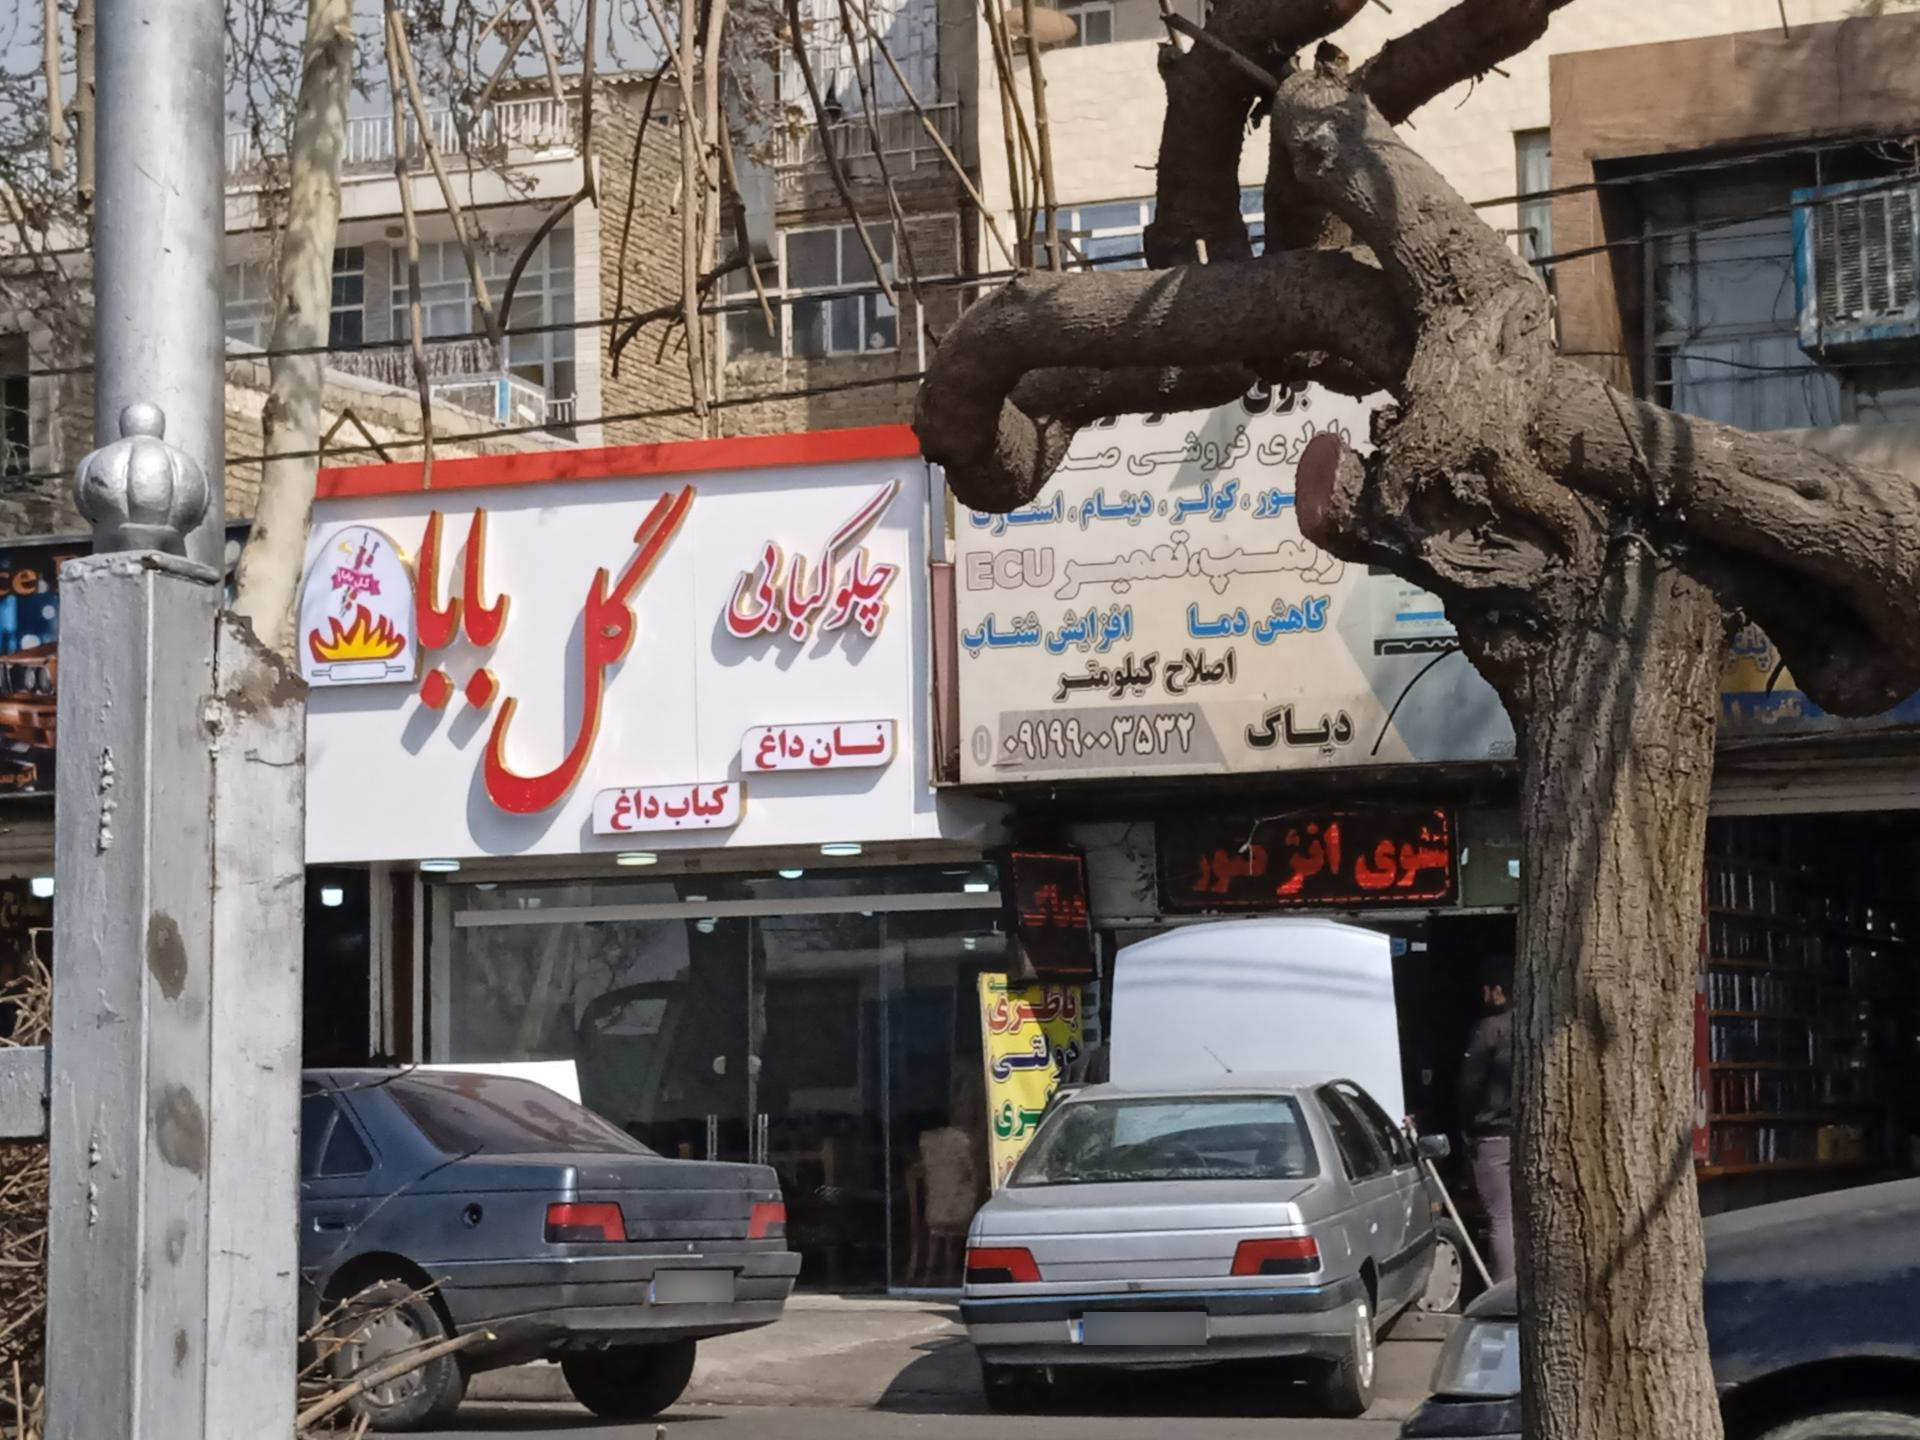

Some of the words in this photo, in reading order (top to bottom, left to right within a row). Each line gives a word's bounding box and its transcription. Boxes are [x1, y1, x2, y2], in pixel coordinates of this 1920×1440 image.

[1127, 424, 1251, 475] فروشی
[969, 490, 1065, 537] استرت
[965, 547, 1055, 592] ECU
[961, 611, 1042, 659] شتاب
[1045, 603, 1134, 655] افزایش
[1186, 602, 1249, 639] دما
[1252, 596, 1331, 645] کاهش
[484, 483, 697, 815] گل
[1162, 646, 1237, 696] اصلاح
[1052, 651, 1161, 702] کیلومتر
[755, 726, 804, 770] داغ
[809, 723, 886, 767] نان
[1003, 712, 1196, 761] ۰۹۱۹۹۰۰۳۵۳۲
[1245, 702, 1354, 757] دیاگ
[610, 787, 659, 831] داغ
[663, 781, 730, 826] کباب
[988, 983, 1079, 1034] باطری
[990, 1034, 1080, 1083] دولتی
